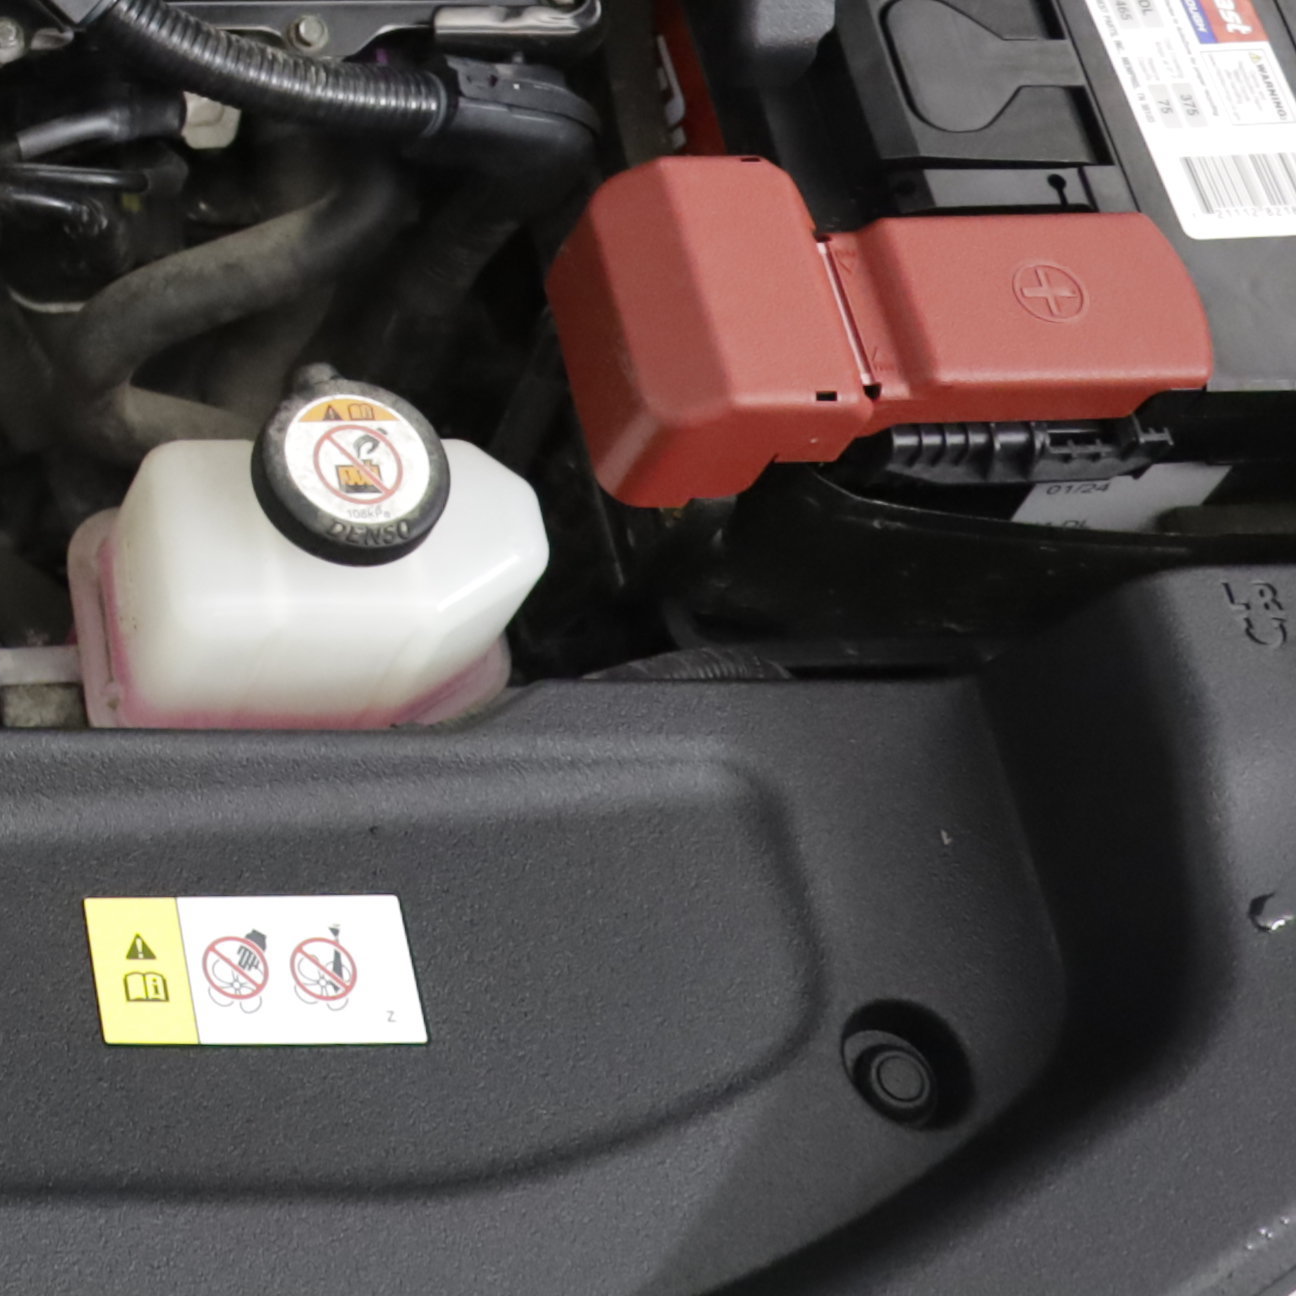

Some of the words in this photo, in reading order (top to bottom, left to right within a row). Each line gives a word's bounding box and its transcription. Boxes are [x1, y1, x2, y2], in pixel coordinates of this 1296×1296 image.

[1158, 99, 1174, 115] 75
[1182, 92, 1199, 118] 375
[1046, 482, 1111, 495] 01/24
[325, 519, 411, 546] DENSO
